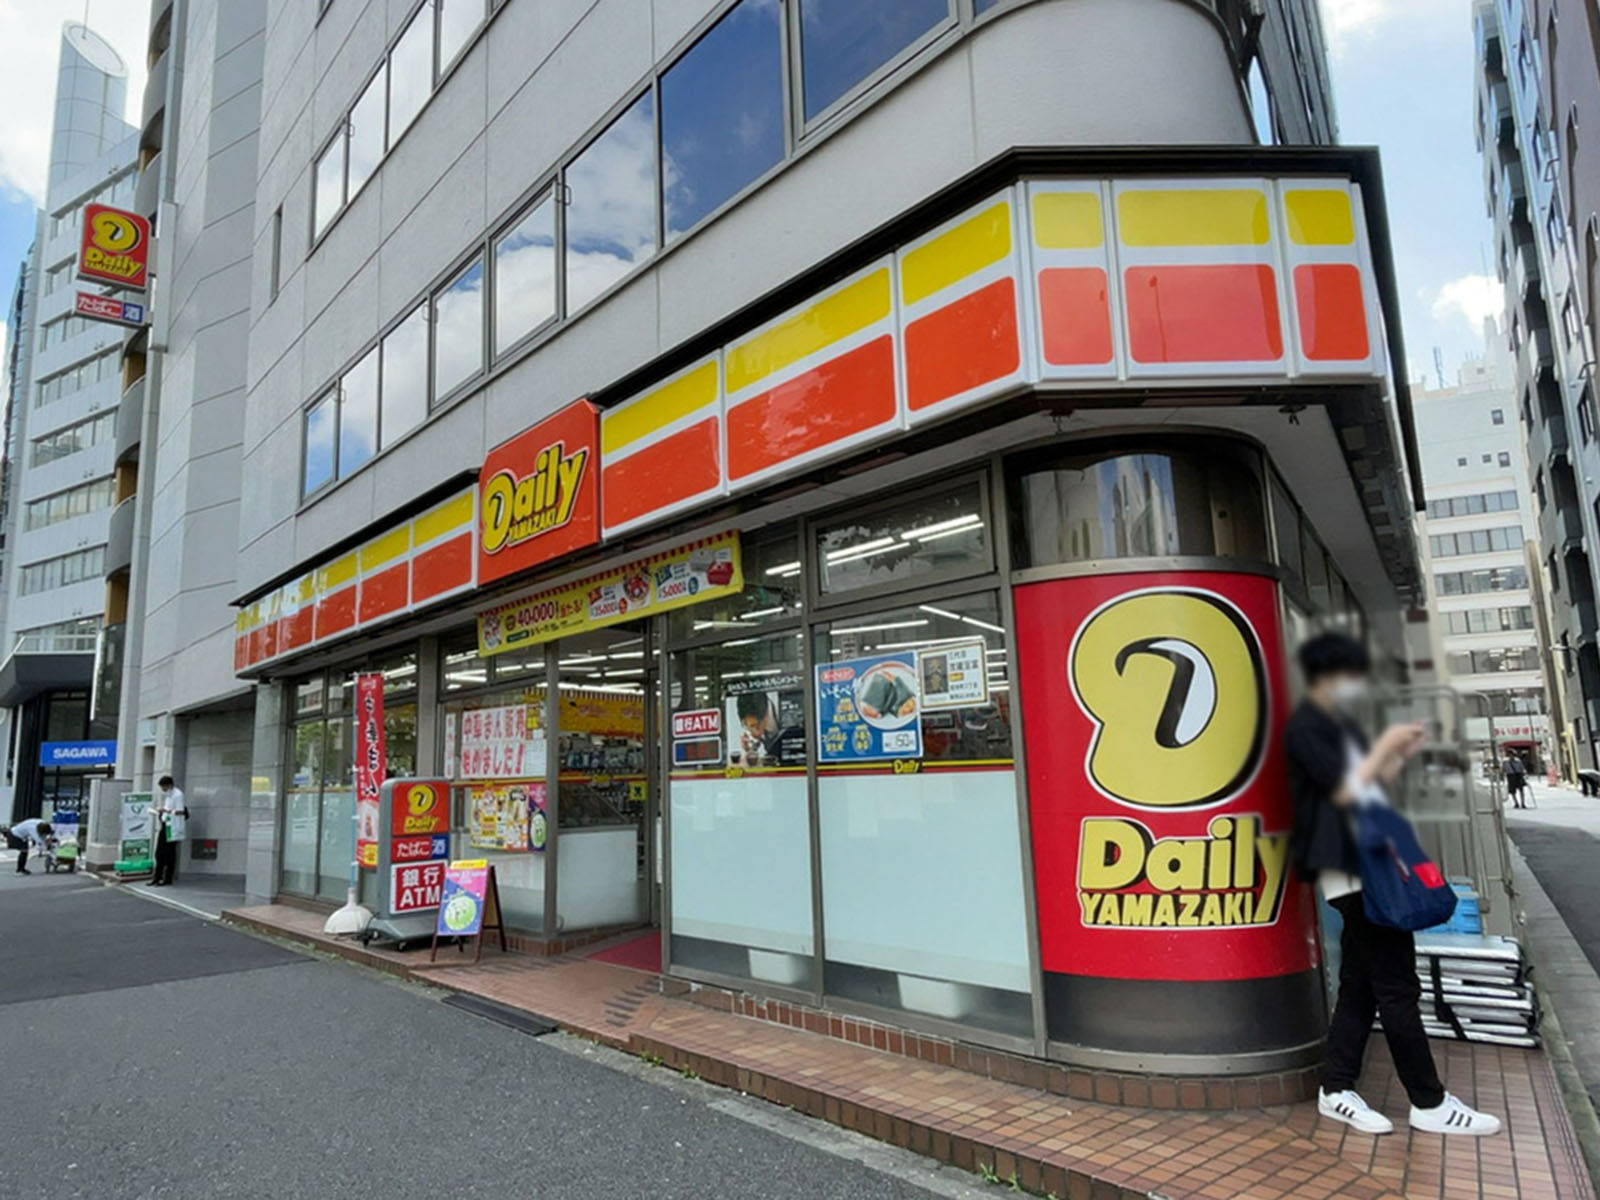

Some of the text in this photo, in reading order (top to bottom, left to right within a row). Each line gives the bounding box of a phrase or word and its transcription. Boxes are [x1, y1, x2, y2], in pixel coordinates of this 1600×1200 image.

[84, 247, 142, 277] Daily
[78, 297, 121, 318] たばこ
[482, 443, 587, 552] Daily
[53, 747, 108, 759] SAGAWA
[403, 815, 438, 834] Daily
[397, 841, 430, 857] たばこ
[431, 838, 446, 855] 酒
[402, 866, 439, 888] 銀行
[1080, 815, 1290, 923] Daily
[400, 885, 440, 908] ATM
[1080, 891, 1253, 926] YAMAZAKI
